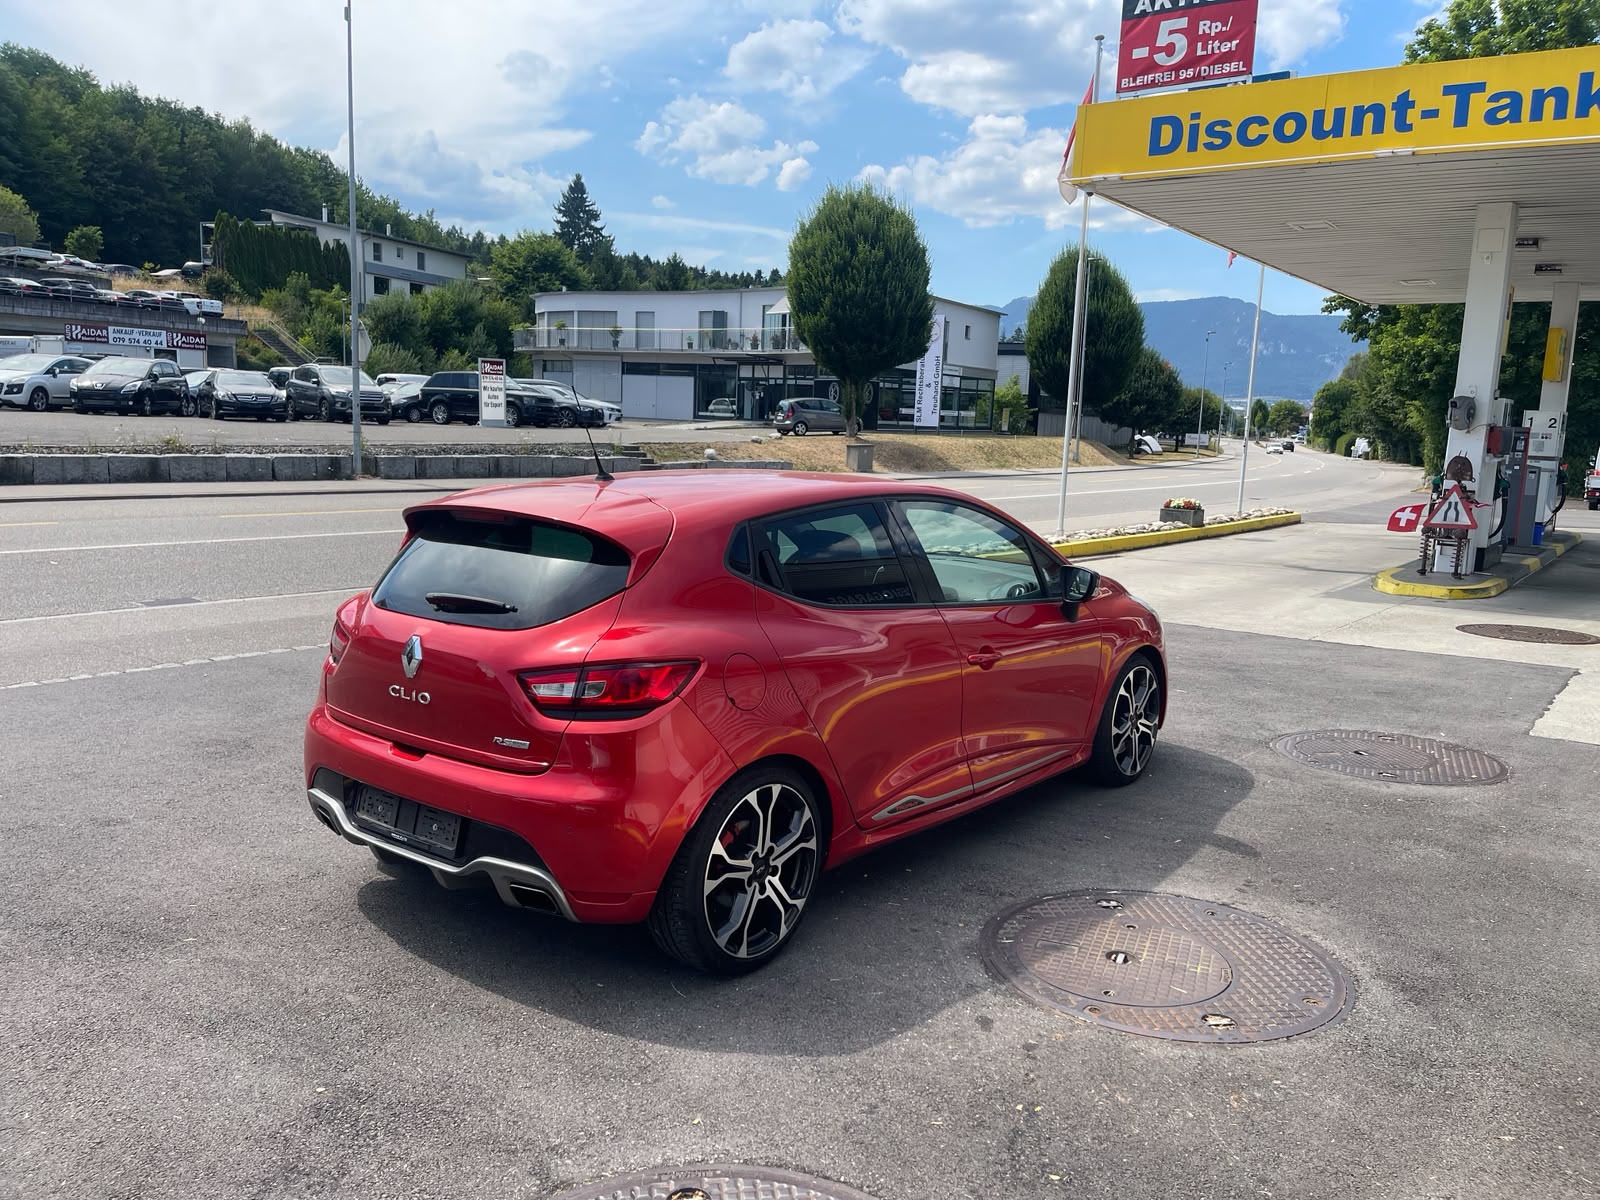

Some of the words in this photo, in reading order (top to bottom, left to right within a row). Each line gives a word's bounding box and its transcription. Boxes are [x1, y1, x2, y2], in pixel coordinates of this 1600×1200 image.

[1132, 17, 1188, 66] -5
[1196, 39, 1239, 56] Liter
[1121, 70, 1175, 88] BLEIFREI
[1148, 71, 1600, 156] Discount-Tank
[128, 337, 140, 345] 574
[917, 355, 926, 405] Rechtsberatu
[931, 381, 939, 415] Treuhand
[1528, 417, 1533, 427] 1
[1548, 417, 1557, 428] 2
[388, 684, 431, 705] CLIO
